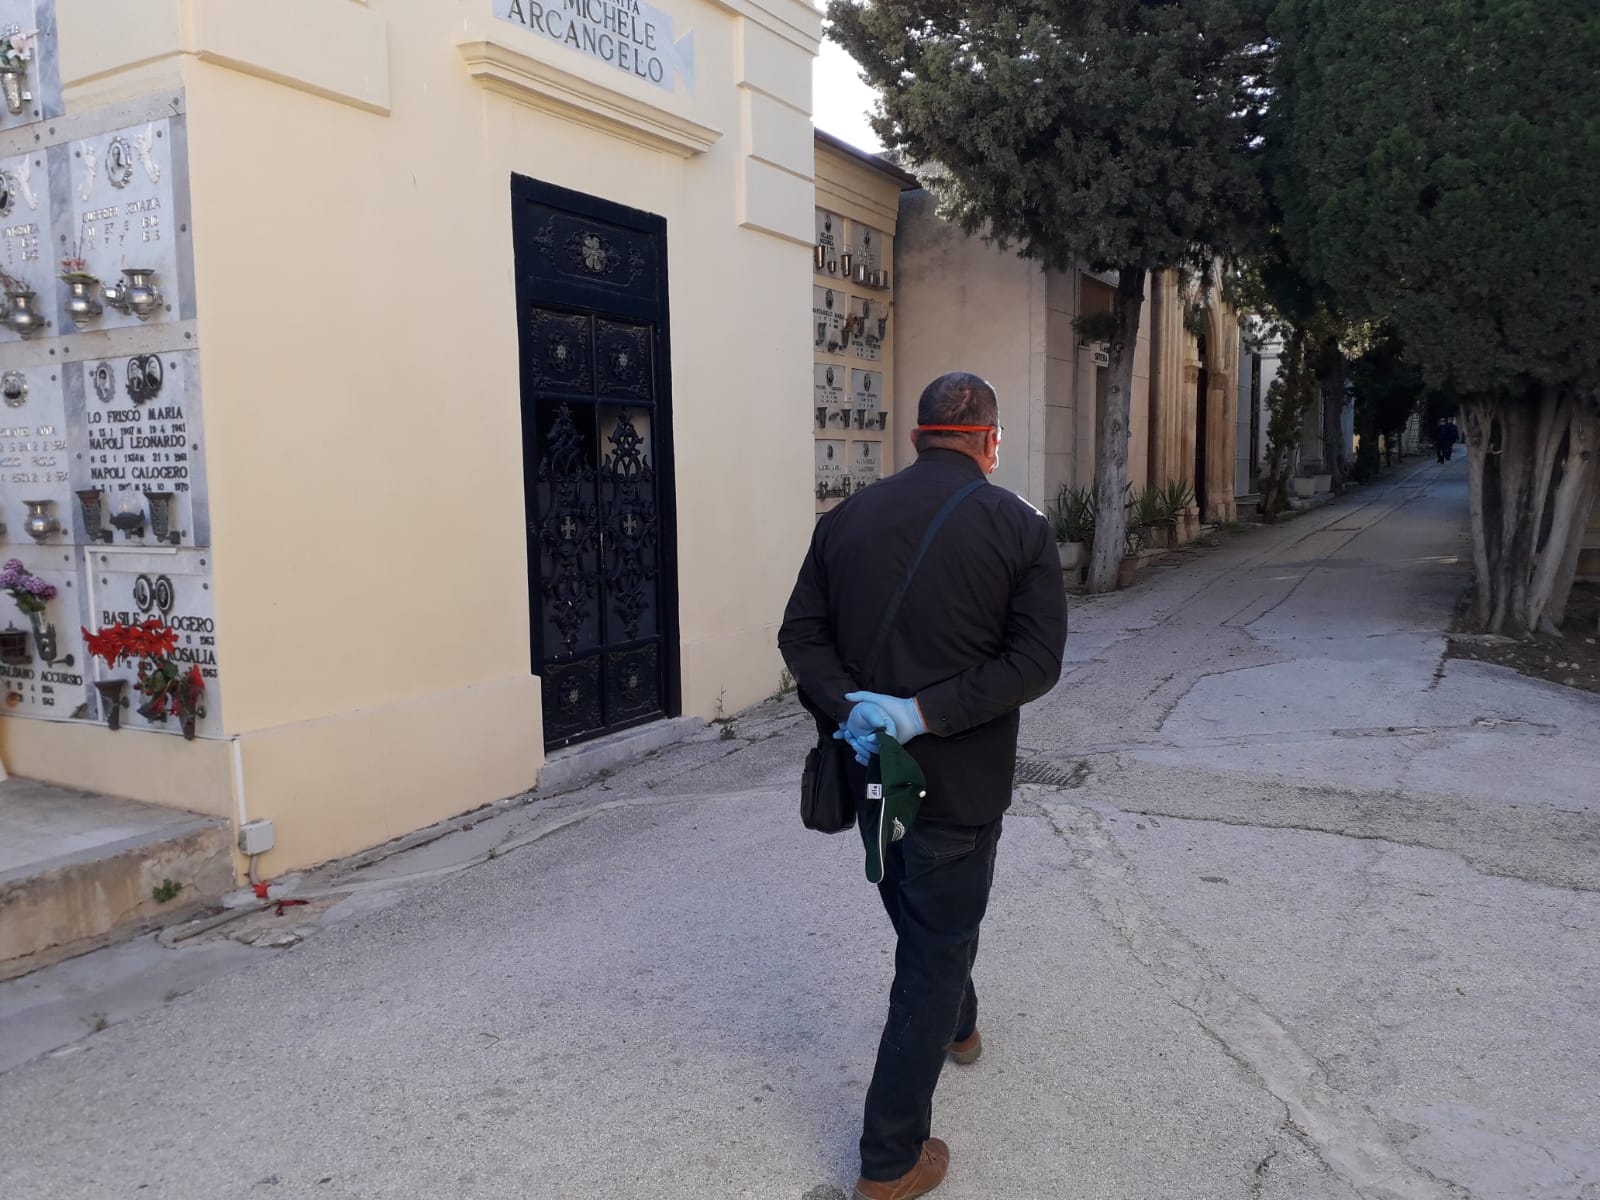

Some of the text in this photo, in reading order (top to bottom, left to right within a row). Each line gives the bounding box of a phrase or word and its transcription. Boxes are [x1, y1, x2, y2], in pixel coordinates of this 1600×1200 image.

[563, 0, 657, 51] MICHELE
[507, 0, 663, 83] ARCANGELO
[87, 406, 184, 424] LO FRISCO MARIA
[89, 434, 186, 450] NAPOLI LEONARDO
[91, 465, 188, 480] NAPOLI CALOGERO
[102, 610, 142, 626] BASILE
[167, 647, 216, 666] ROSALIA
[41, 671, 83, 686] ACCURSIO
